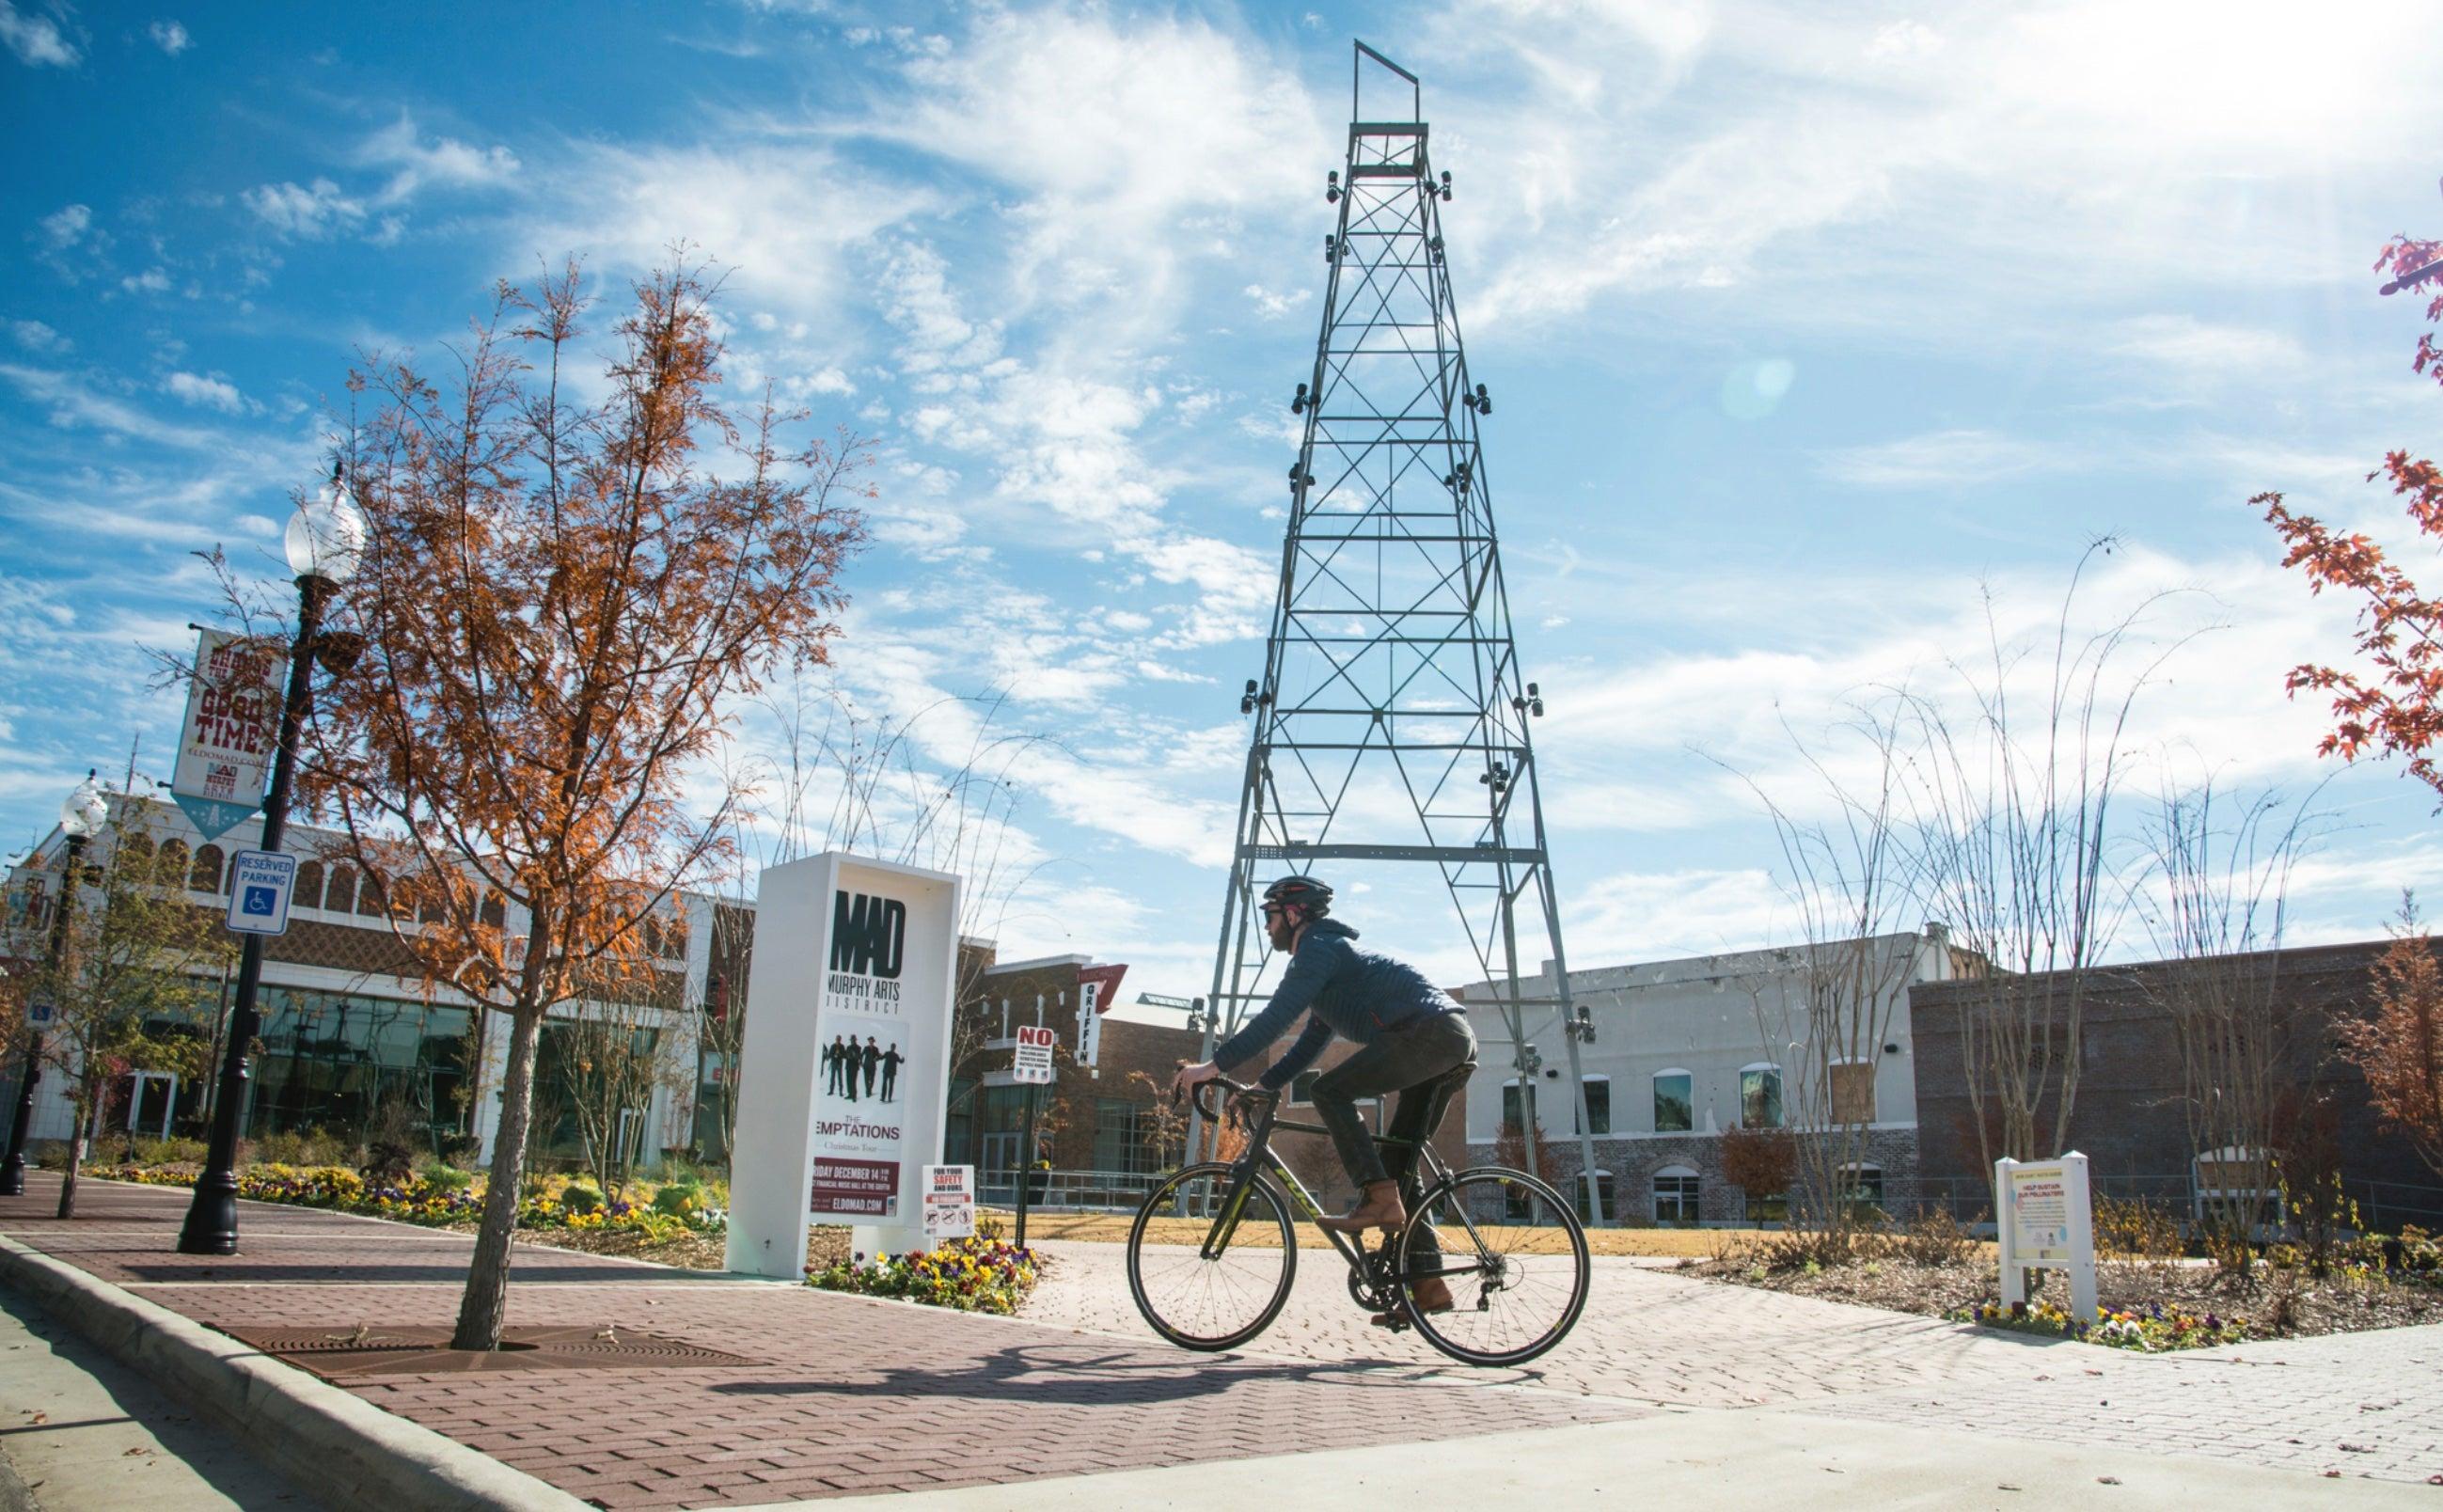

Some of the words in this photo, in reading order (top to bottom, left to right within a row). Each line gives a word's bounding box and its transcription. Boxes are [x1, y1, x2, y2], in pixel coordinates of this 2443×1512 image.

[241, 857, 292, 874] RESERVED
[242, 871, 287, 887] PARKING
[829, 890, 906, 980] MAD
[874, 980, 901, 1002] ARTS
[1080, 984, 1095, 1063] GRIFFIN
[1019, 1028, 1052, 1047] NO
[845, 1114, 861, 1123] THE
[824, 1141, 859, 1152] Christmas
[862, 1143, 877, 1153] Tour
[833, 1166, 871, 1181] DECEMBER
[871, 1168, 879, 1181] 14
[933, 1174, 963, 1185] SAFETY
[832, 1197, 883, 1212] ELDOMAD.COM
